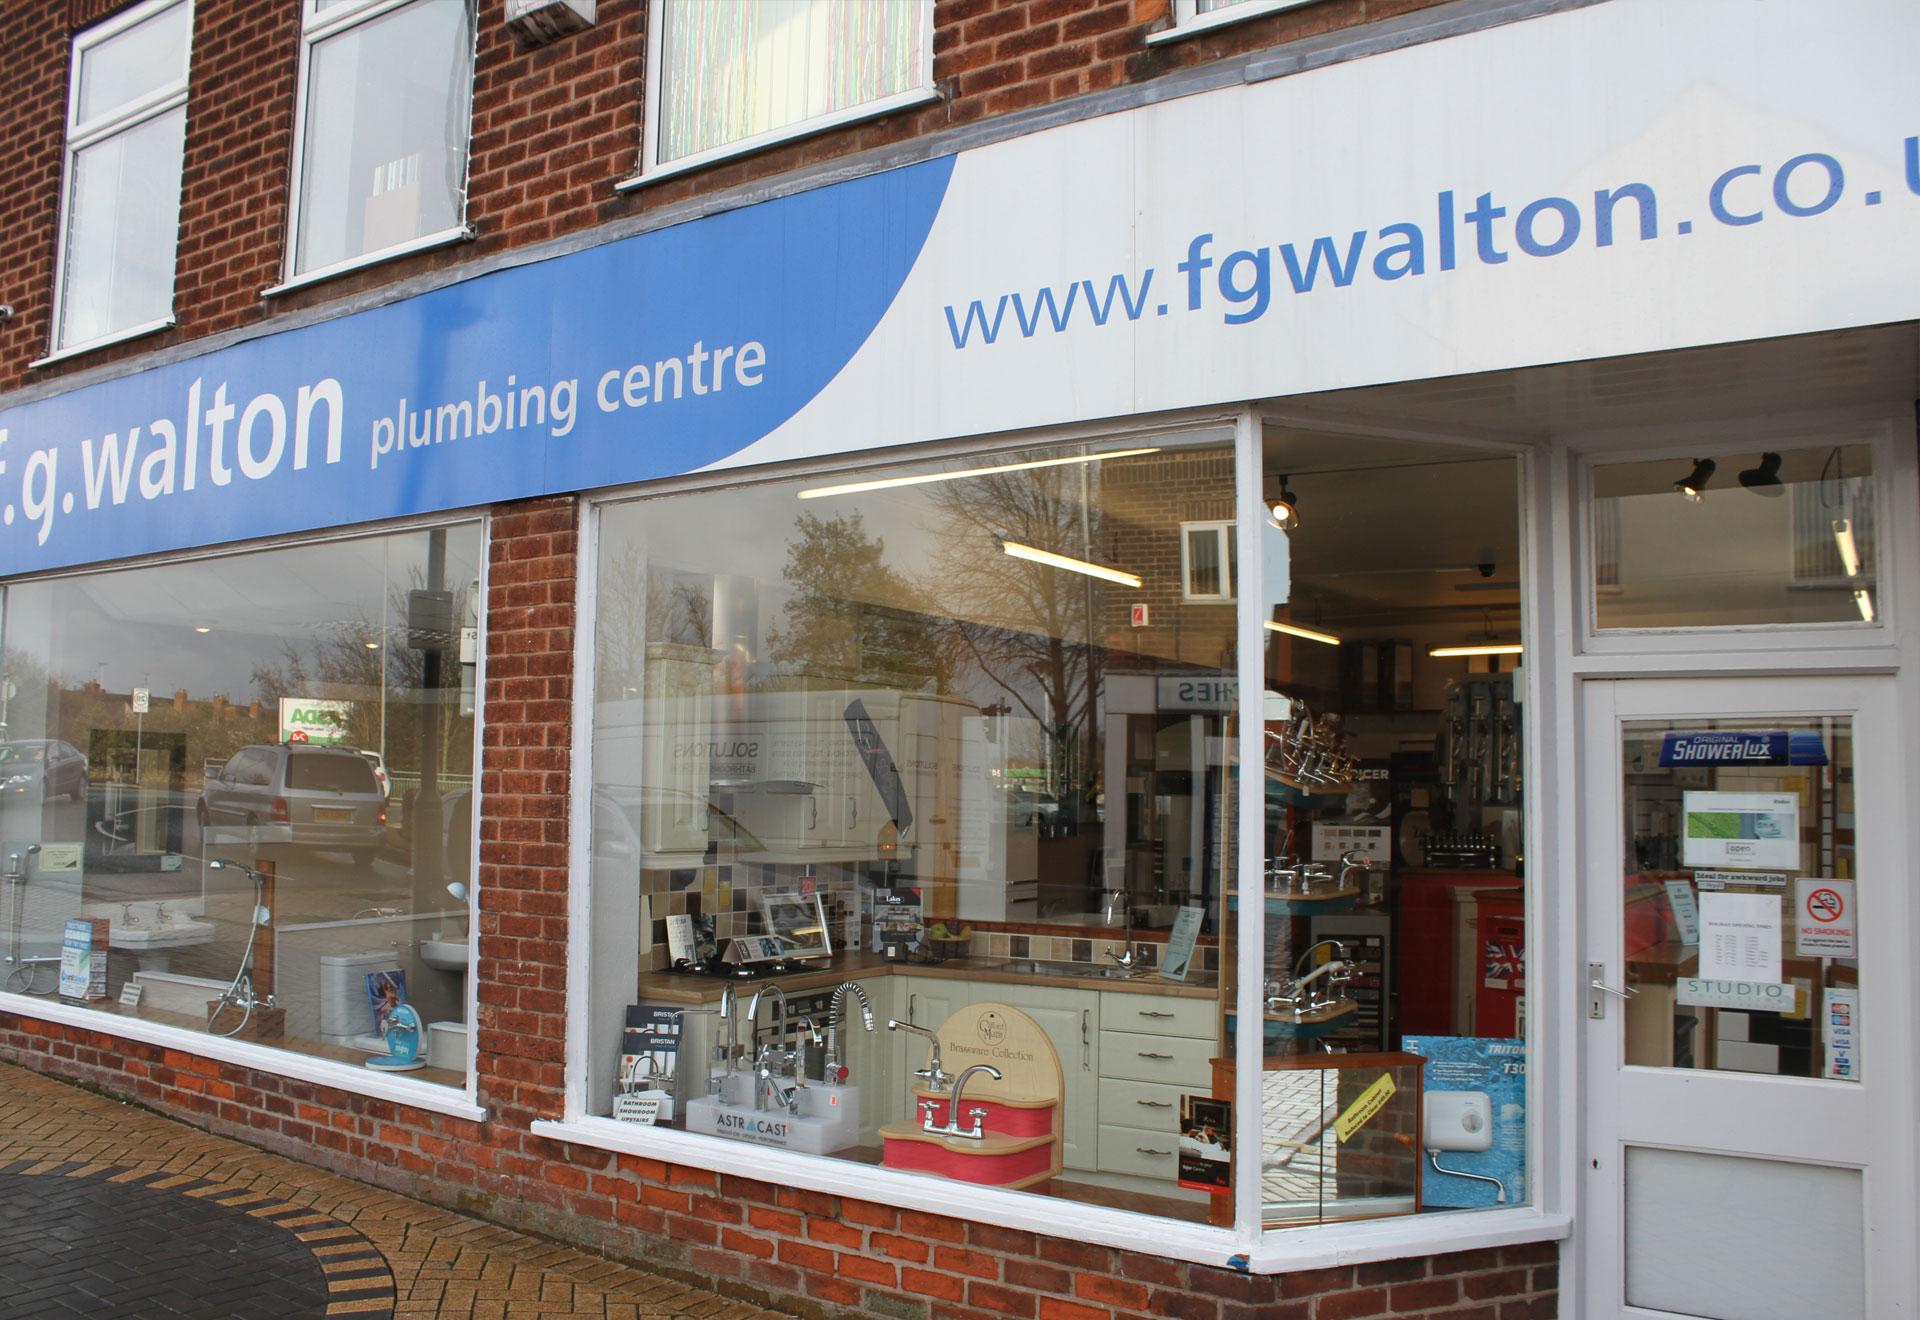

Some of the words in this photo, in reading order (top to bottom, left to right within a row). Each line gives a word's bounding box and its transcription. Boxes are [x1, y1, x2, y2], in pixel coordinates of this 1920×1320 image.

[371, 375, 577, 469] plumbing
[597, 341, 765, 412] centre
[1693, 736, 1740, 744] ORIGINAL
[1688, 980, 1783, 998] STUDIO
[992, 1047, 1034, 1061] Collection
[623, 1100, 657, 1108] BATHROOM
